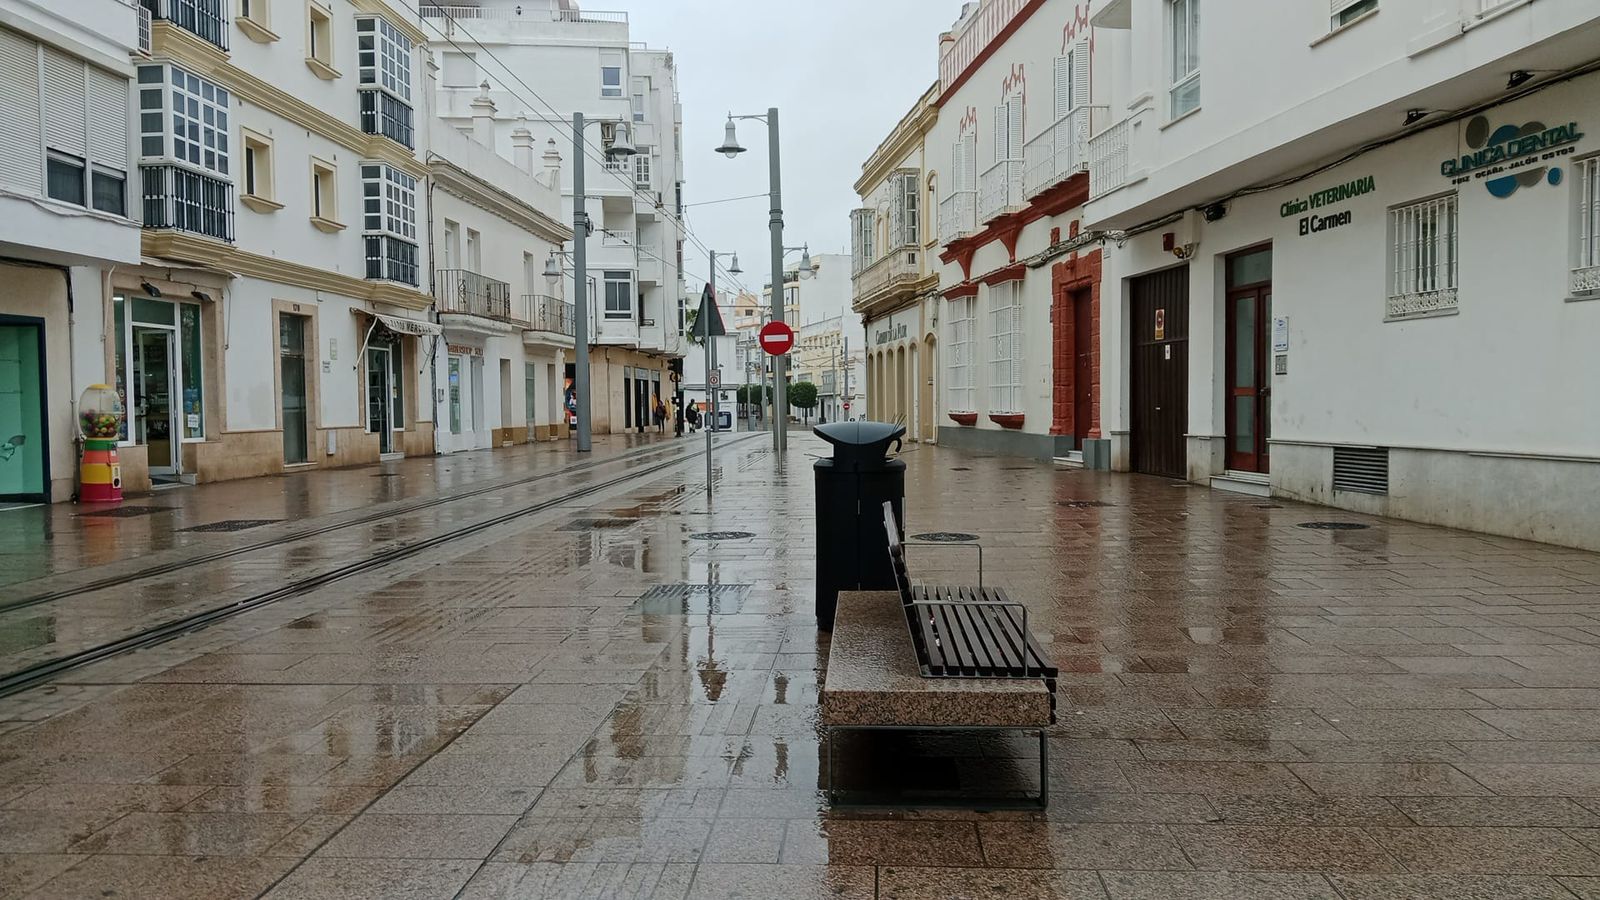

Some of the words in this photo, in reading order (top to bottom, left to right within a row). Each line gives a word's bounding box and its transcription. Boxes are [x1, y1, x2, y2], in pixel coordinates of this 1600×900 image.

[1507, 121, 1584, 157] DENTAL
[1541, 146, 1575, 160] OSTOS
[1280, 198, 1309, 218] Clínica
[1309, 175, 1375, 209] VETERINARIA
[1299, 217, 1309, 236] El
[1310, 210, 1351, 233] Carmen
